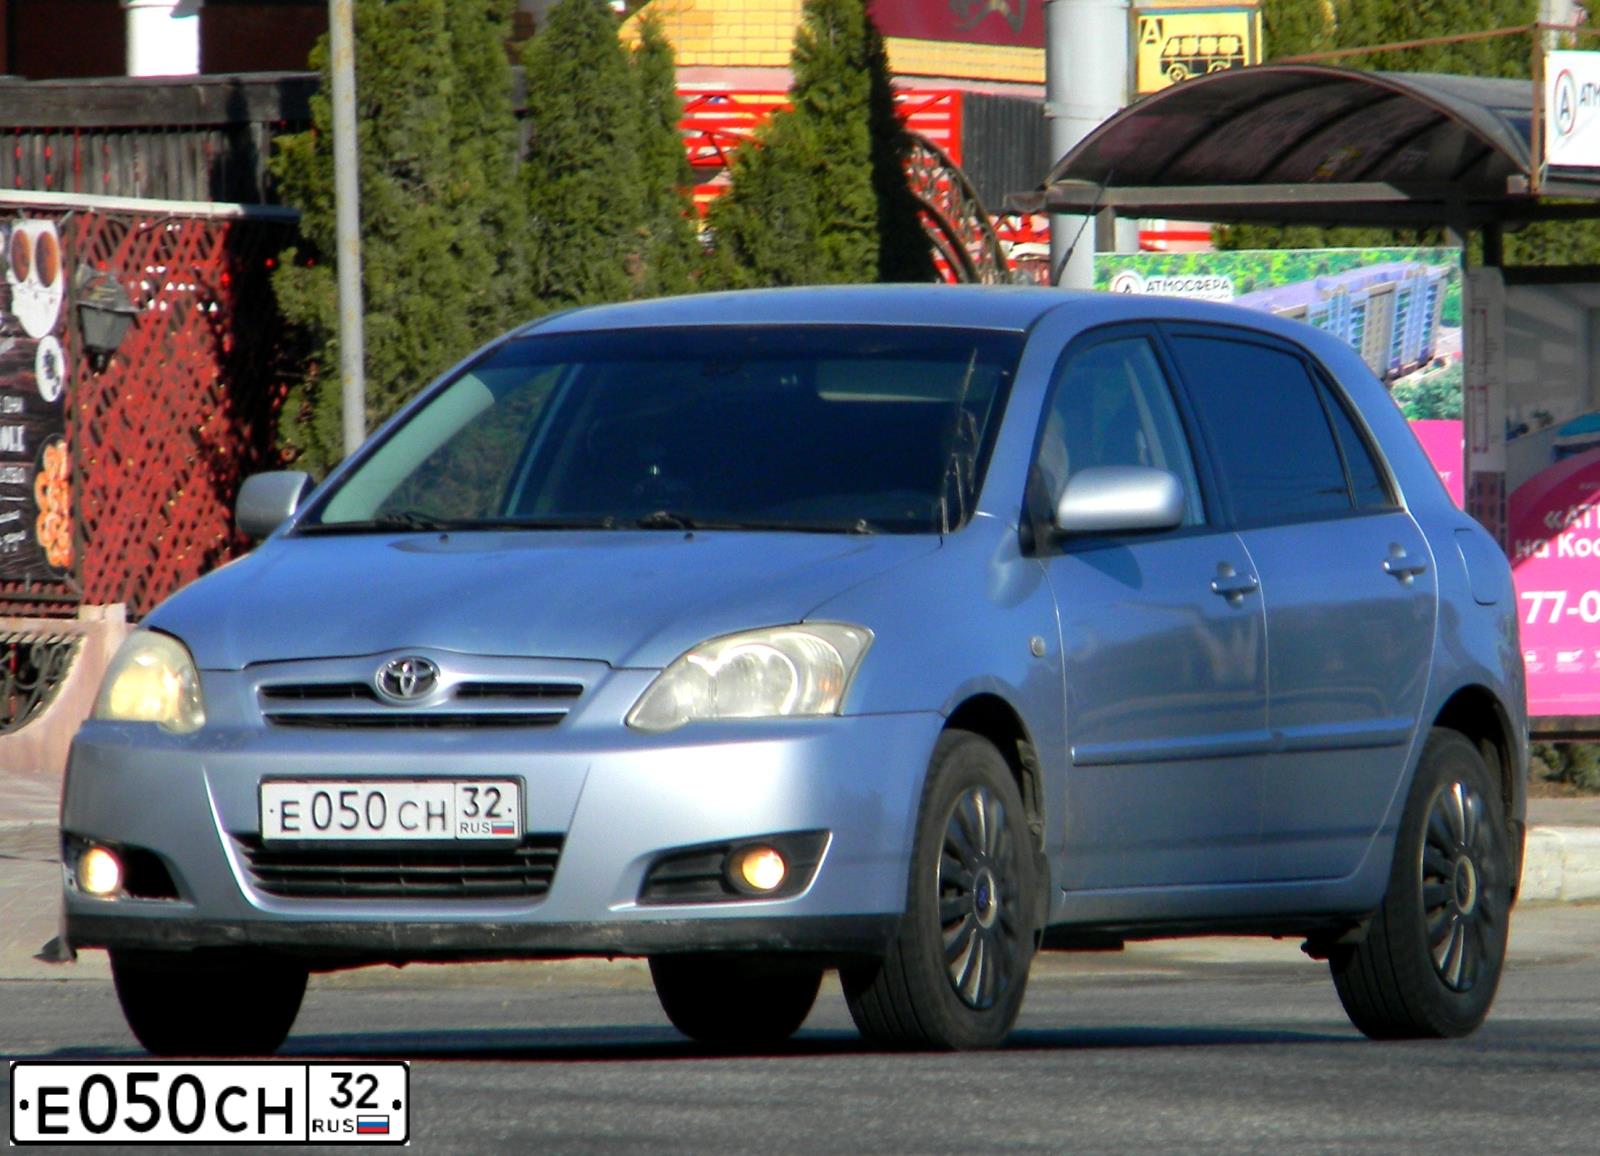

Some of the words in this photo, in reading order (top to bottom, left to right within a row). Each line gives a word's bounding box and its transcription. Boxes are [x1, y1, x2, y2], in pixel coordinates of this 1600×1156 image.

[1145, 279, 1229, 293] АТМОСФЕРА
[1544, 503, 1600, 529] «АТ
[1515, 537, 1550, 559] на
[462, 787, 502, 818] 32
[459, 821, 490, 833] RUS
